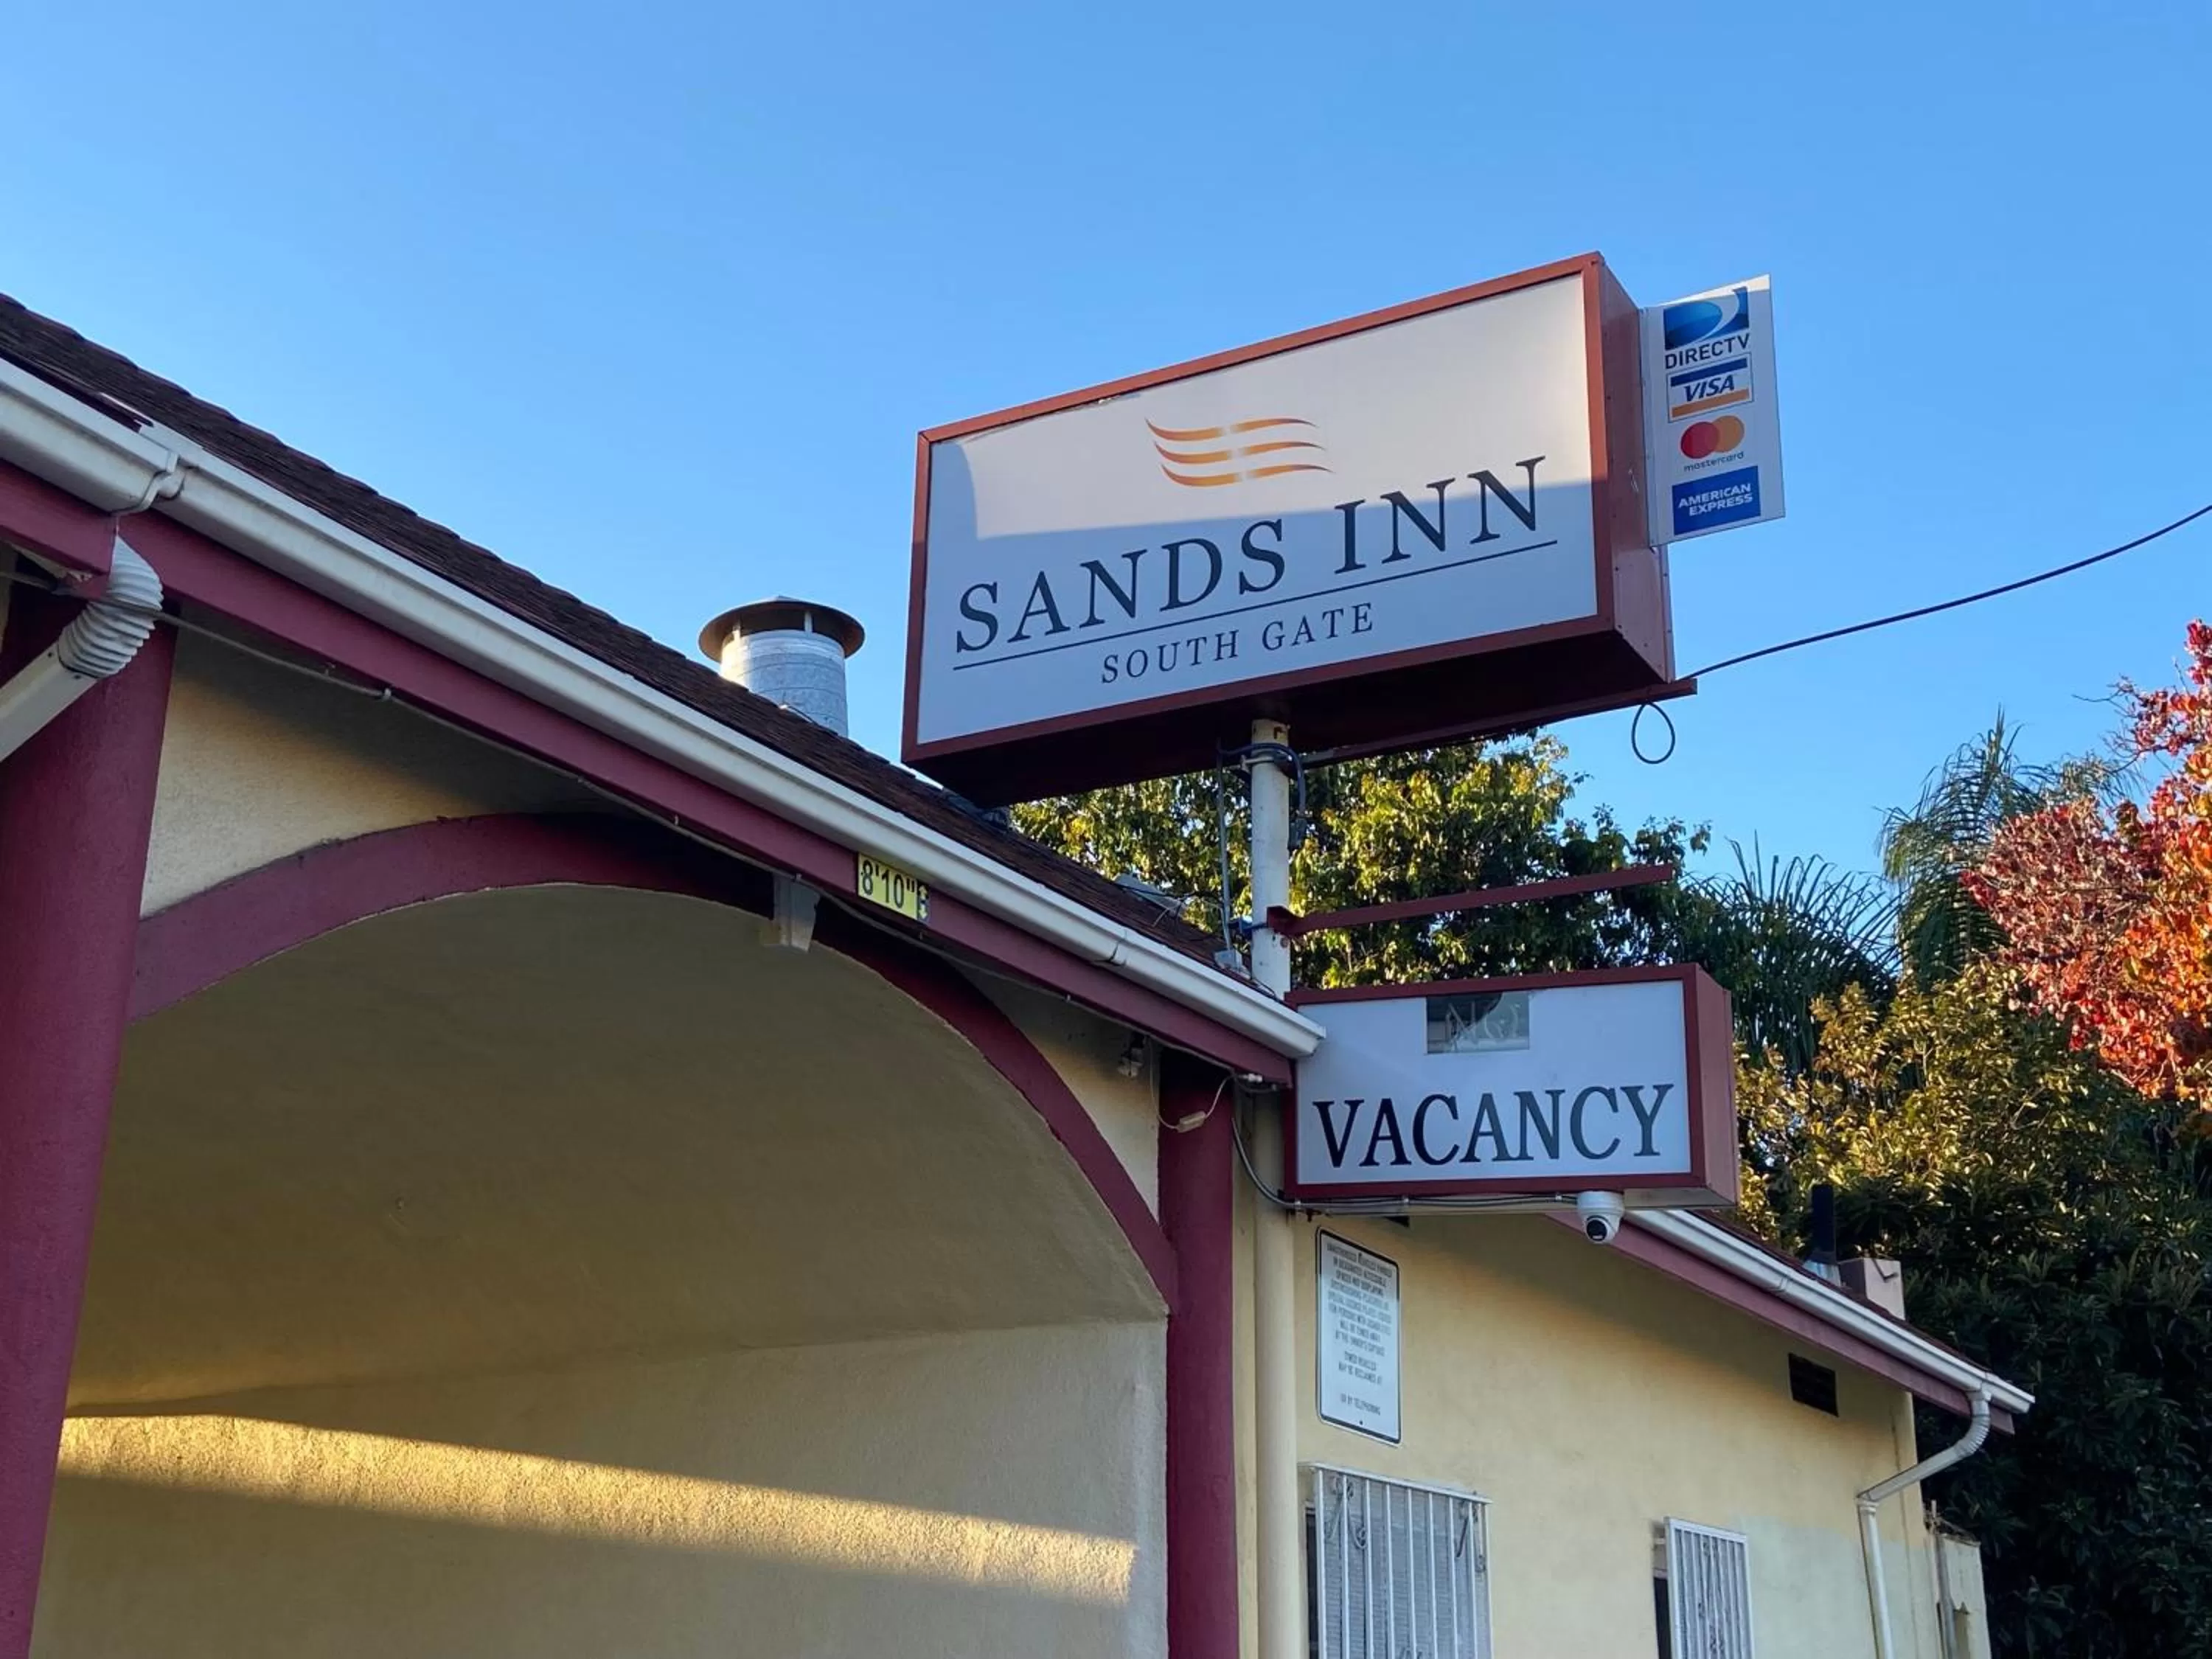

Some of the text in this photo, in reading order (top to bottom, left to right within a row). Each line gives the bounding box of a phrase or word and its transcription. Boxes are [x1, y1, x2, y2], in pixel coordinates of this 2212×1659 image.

[1665, 333, 1750, 369] DIRECTV
[1684, 375, 1735, 402] VISA
[1683, 451, 1745, 473] mastercard
[1678, 483, 1751, 509] AMERICAN
[1689, 493, 1753, 517] EXPRESS
[956, 455, 1545, 653] SANDS INN
[1101, 602, 1374, 684] SOUTH GATE
[1313, 1084, 1674, 1168] VACANCY
